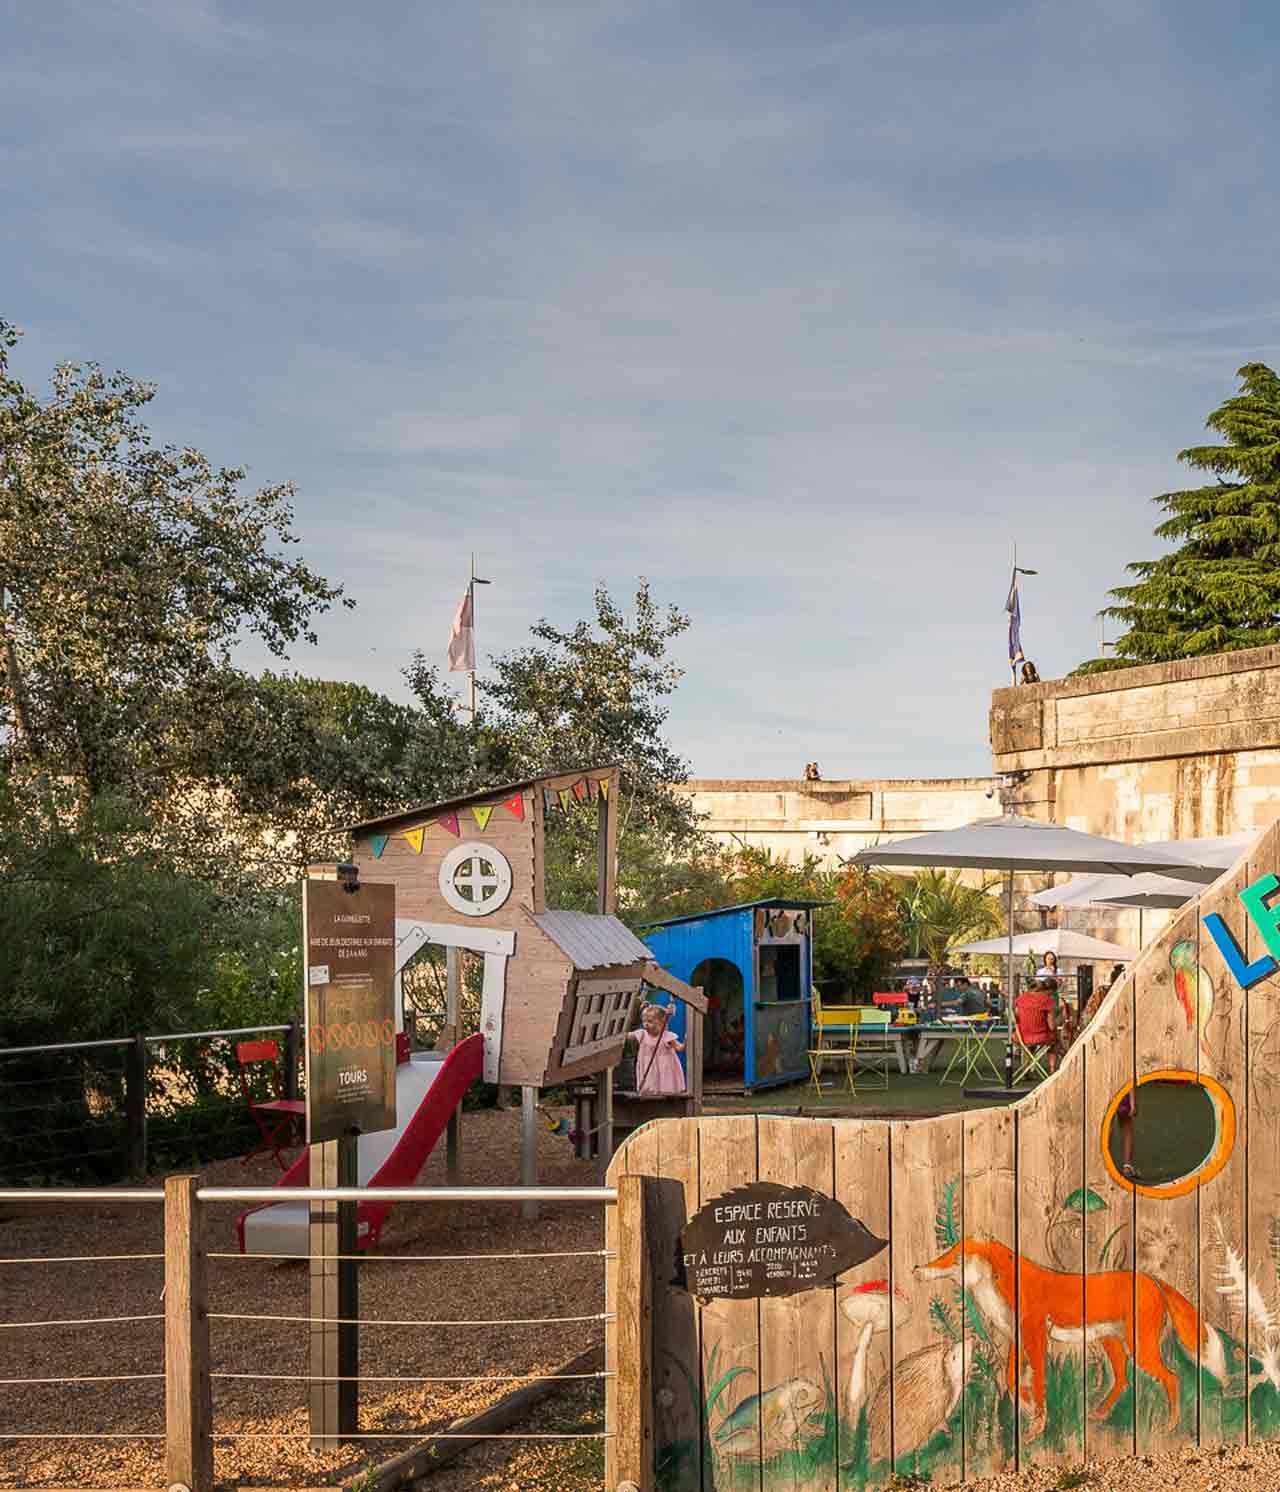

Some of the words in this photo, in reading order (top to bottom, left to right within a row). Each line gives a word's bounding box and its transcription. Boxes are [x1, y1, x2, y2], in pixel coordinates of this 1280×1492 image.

[339, 1070, 368, 1086] TOURS
[714, 1202, 762, 1223] ESPACE
[723, 1229, 746, 1245] AUX
[755, 1224, 807, 1244] ENFANTS
[683, 1253, 697, 1267] ET
[699, 1250, 708, 1265] À
[713, 1251, 744, 1265] LEURS
